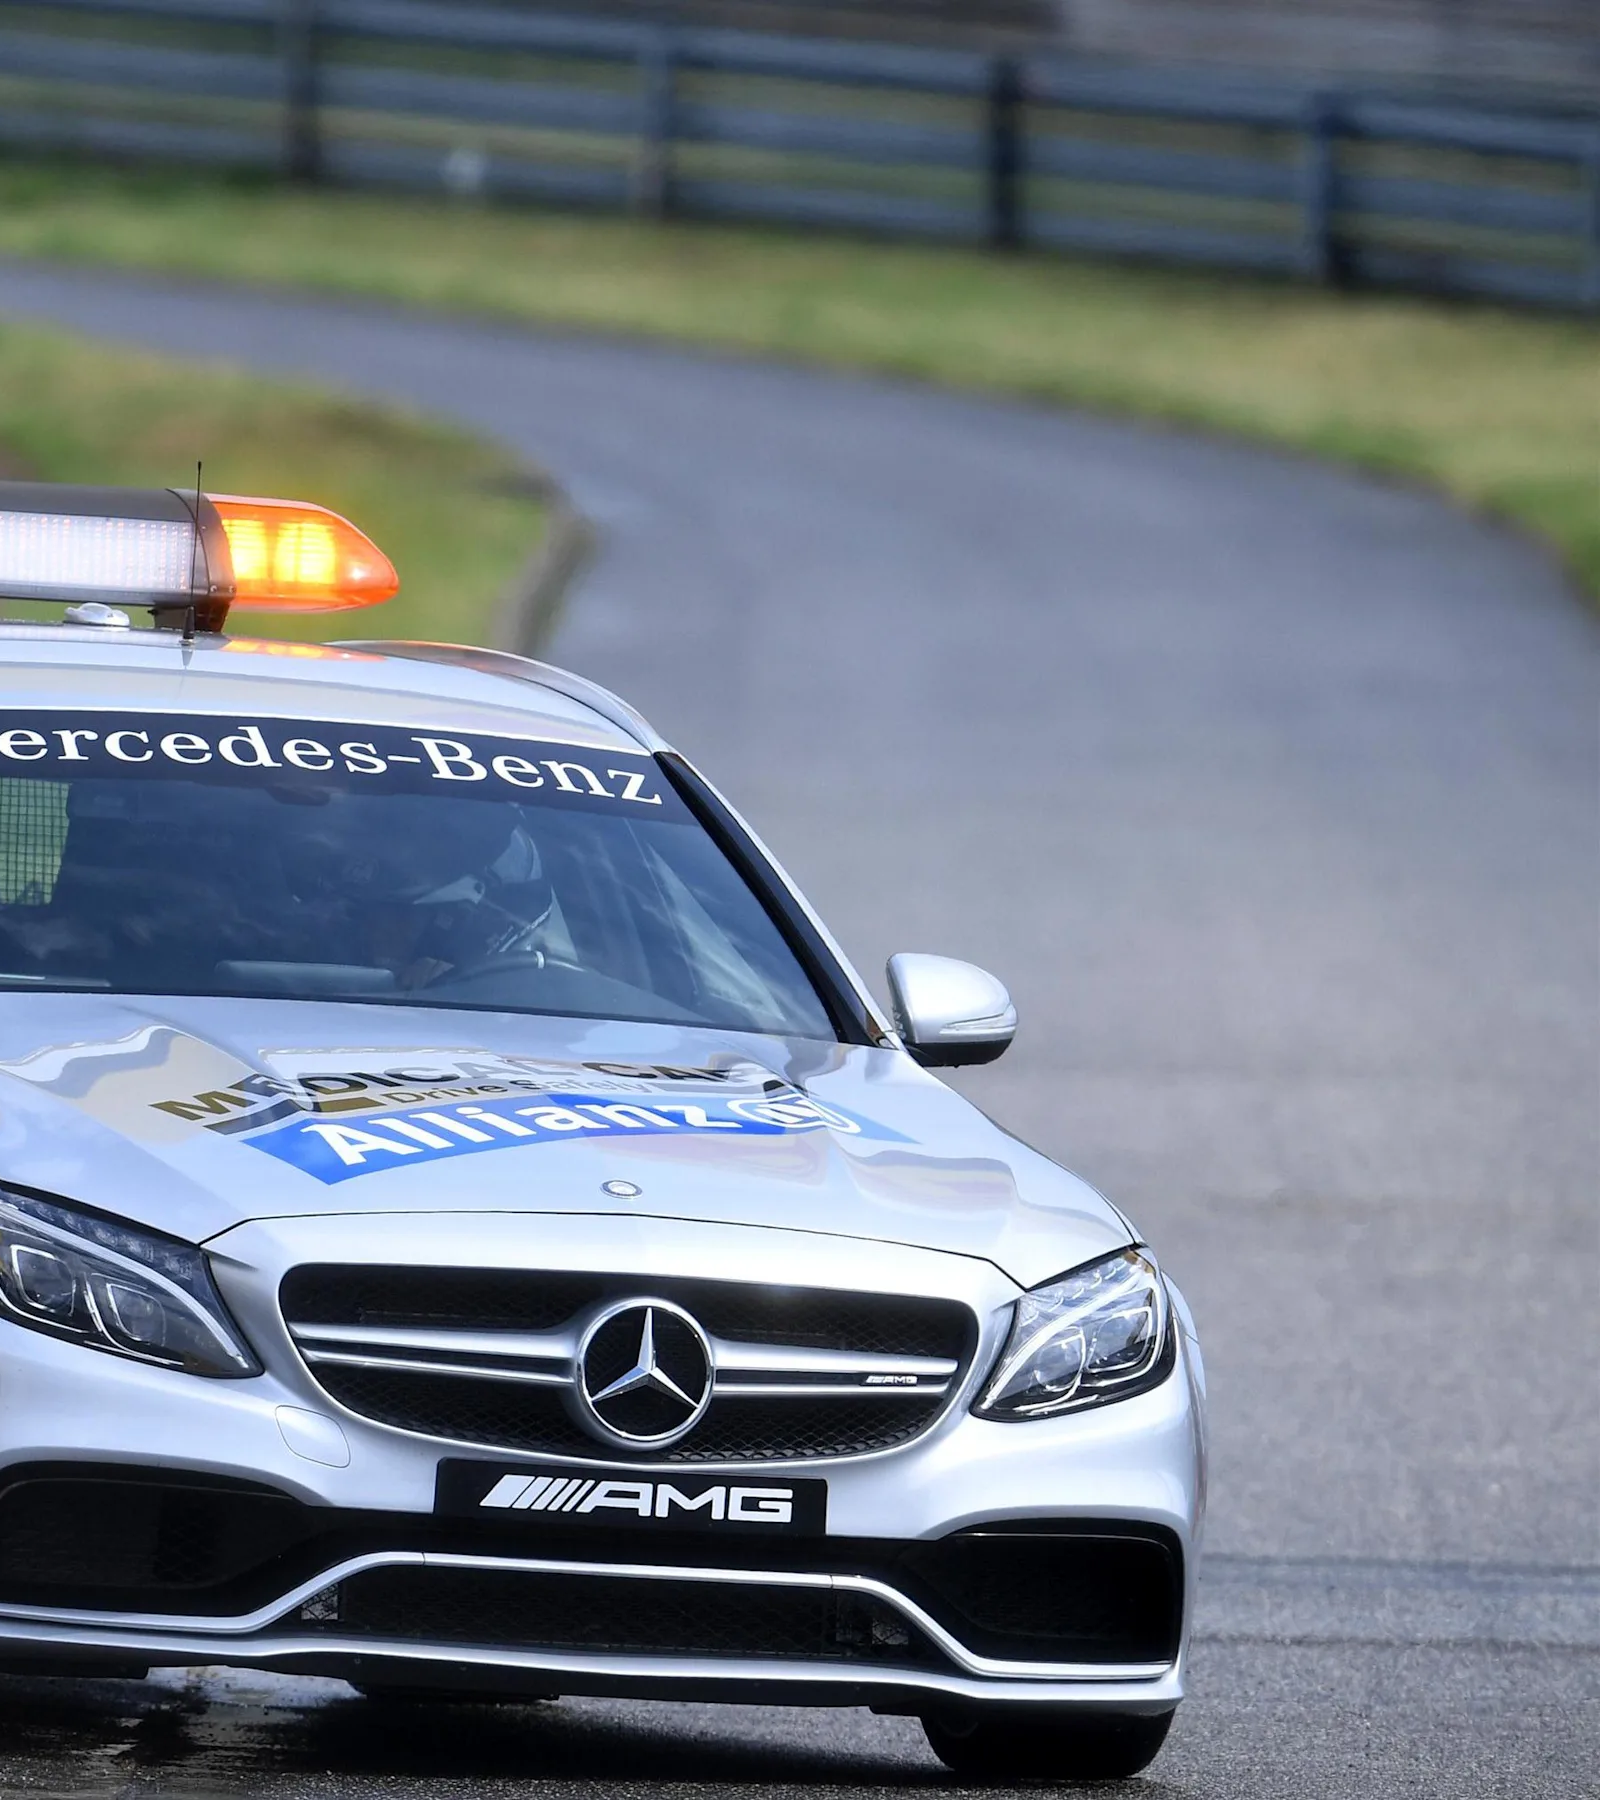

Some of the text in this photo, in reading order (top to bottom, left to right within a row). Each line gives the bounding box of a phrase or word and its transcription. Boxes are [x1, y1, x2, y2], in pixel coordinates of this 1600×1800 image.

[380, 1083, 509, 1104] Drive
[300, 1103, 743, 1166] Allianz
[575, 1480, 793, 1523] AMG
